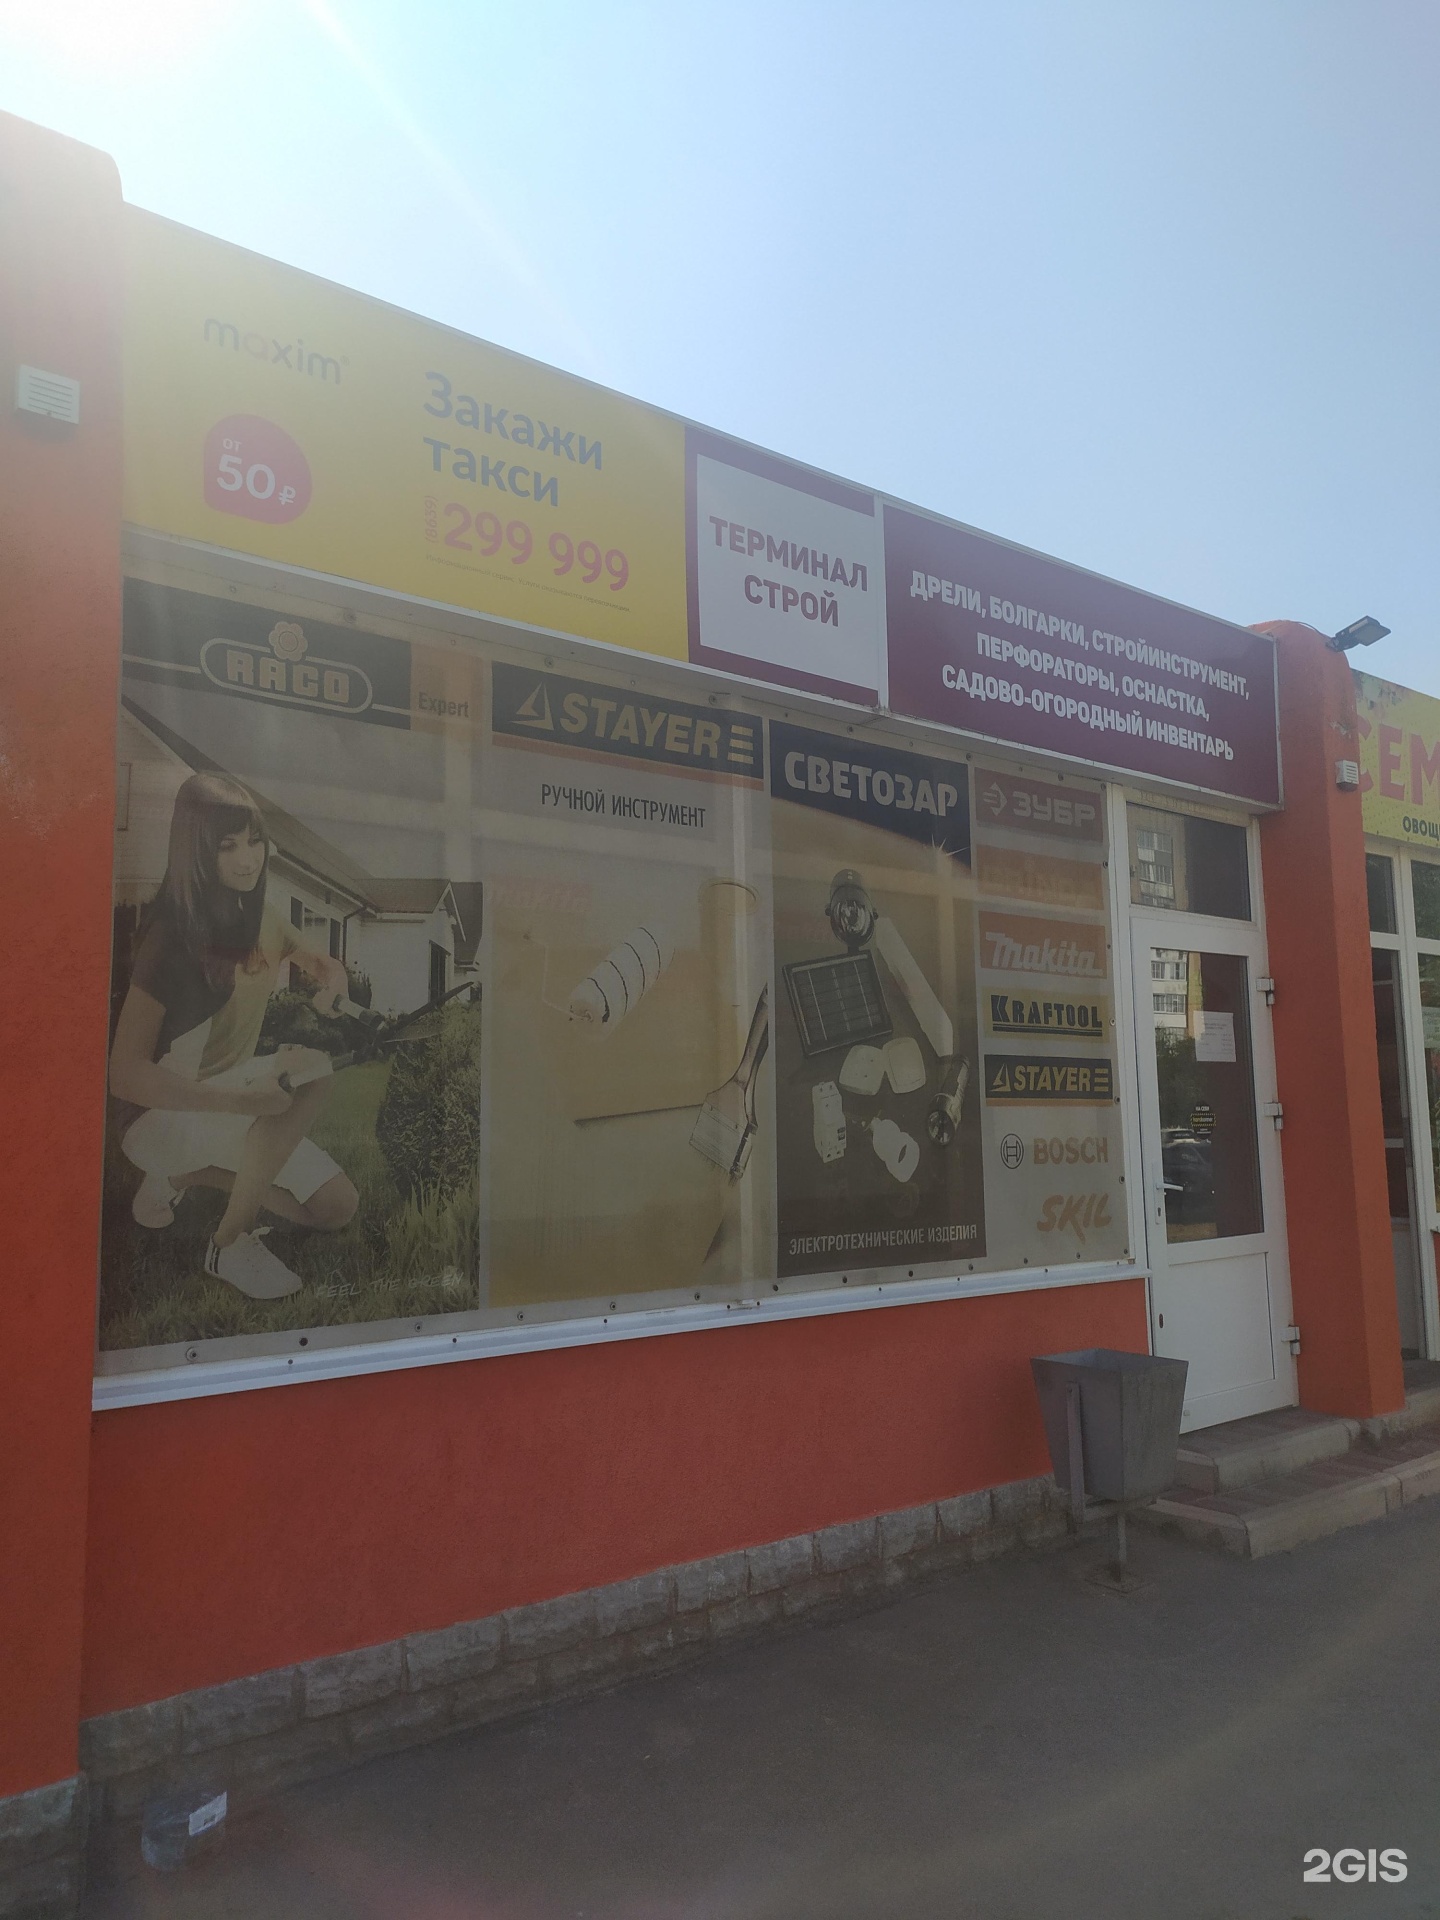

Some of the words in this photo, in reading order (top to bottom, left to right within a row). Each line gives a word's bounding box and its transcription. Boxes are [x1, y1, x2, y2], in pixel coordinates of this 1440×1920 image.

[423, 371, 602, 470] Закажи
[422, 437, 559, 507] такси
[443, 502, 534, 565] 299
[548, 532, 630, 592] 999
[709, 515, 868, 592] ТЕРМИНАЛ
[744, 574, 839, 627] СТРОЙ
[910, 570, 987, 619] ДРЕЛИ,
[989, 595, 1090, 650] БОЛГАРКИ,
[1092, 629, 1250, 700] СТРОЙИНСТРУМЕНТ,
[226, 650, 350, 705] RACO
[977, 632, 1119, 697] ПЕРФОРАТОРЫ,
[1122, 675, 1210, 722] ОСНАСТКА,
[418, 691, 470, 720] Expert
[559, 691, 722, 759] STAYER
[942, 664, 1143, 737] САДОВО-ОГОРОДНЫЙ
[1146, 718, 1234, 761] ИНВЕНТАРЬ
[541, 783, 606, 815] РУЧНОЙ
[612, 794, 706, 828] ИНСТРУМЕНТ
[784, 751, 958, 817] СВЕТОЗАР
[1012, 791, 1096, 828] ЗУБР
[990, 994, 1103, 1028] KRAFTOOL
[1014, 1065, 1091, 1092] STAYER
[1033, 1137, 1109, 1165] BOSCH
[789, 1227, 925, 1256] ЭЛЕКТРОТЕХНИЧЕСКИЕ
[928, 1224, 977, 1244] ИЗДЕЛИЯ
[1037, 1193, 1112, 1243] SKIL
[369, 1277, 401, 1292] THE
